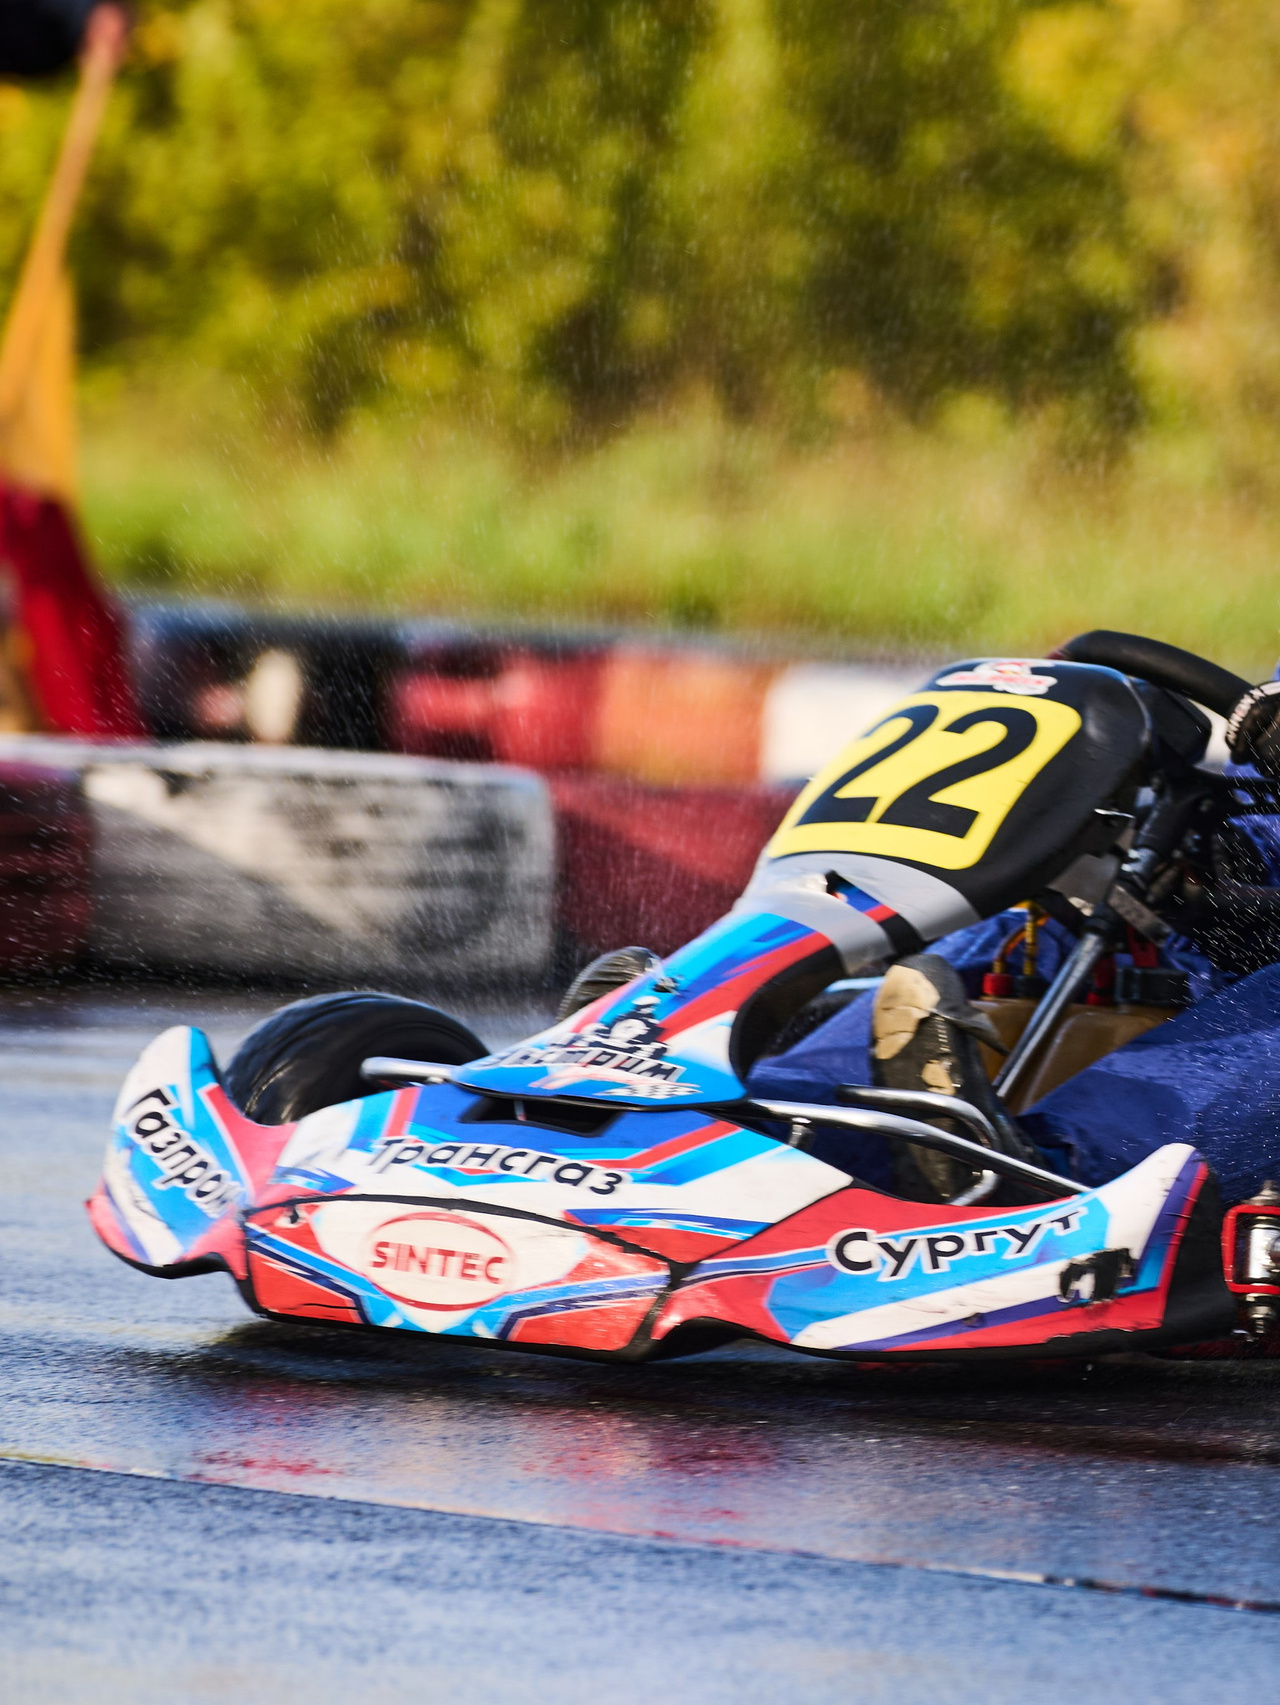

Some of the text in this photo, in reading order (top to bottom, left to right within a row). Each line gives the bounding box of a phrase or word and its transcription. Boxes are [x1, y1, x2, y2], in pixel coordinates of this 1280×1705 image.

[795, 703, 1038, 839] 22
[370, 1138, 623, 1195] Трансгаз
[833, 1211, 1080, 1277] Сургут
[371, 1240, 506, 1285] SINTEC
